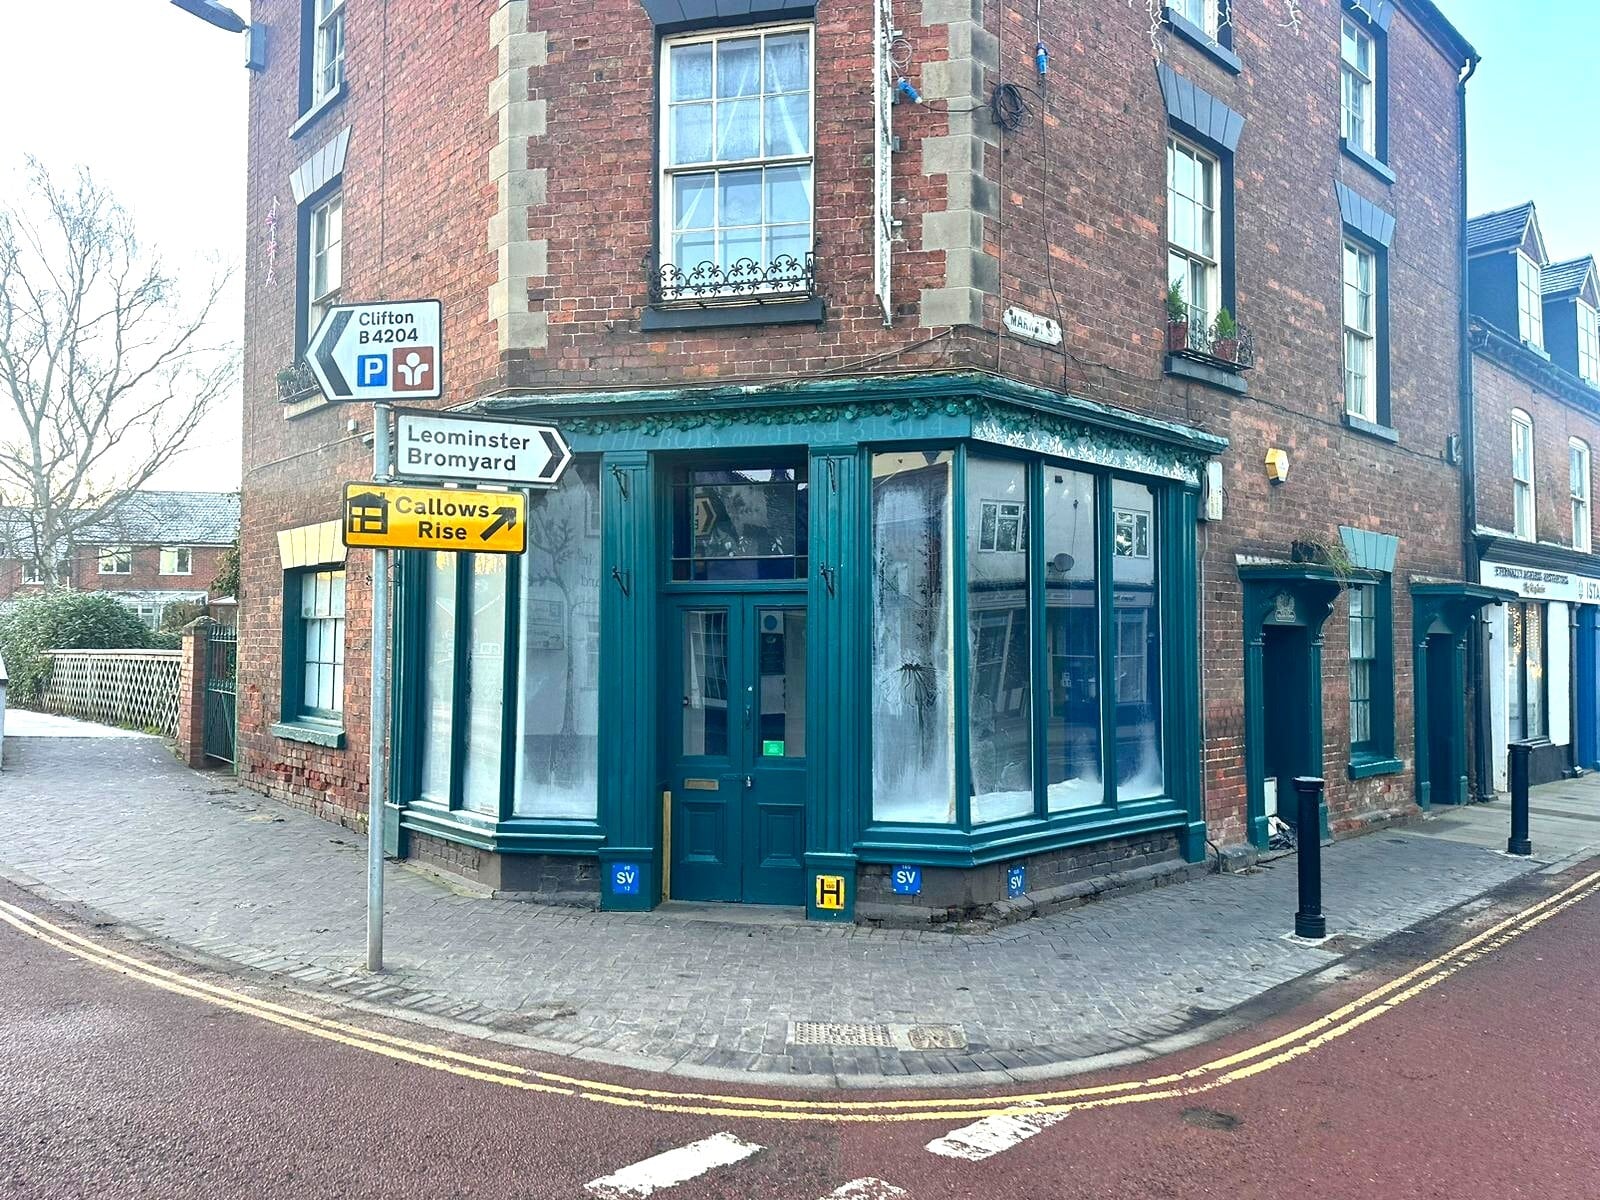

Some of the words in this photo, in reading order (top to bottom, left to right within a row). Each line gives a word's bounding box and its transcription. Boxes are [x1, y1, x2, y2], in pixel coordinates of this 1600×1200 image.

[358, 311, 414, 327] Clifton
[359, 327, 419, 345] B4204
[364, 357, 384, 384] P
[407, 424, 530, 451] Leominster
[407, 447, 517, 472] Bromyard
[395, 495, 490, 518] Callows
[418, 520, 468, 540] Rise
[617, 872, 635, 884] SV
[897, 871, 916, 883] SV
[1011, 875, 1022, 889] SV
[820, 878, 841, 905] H
